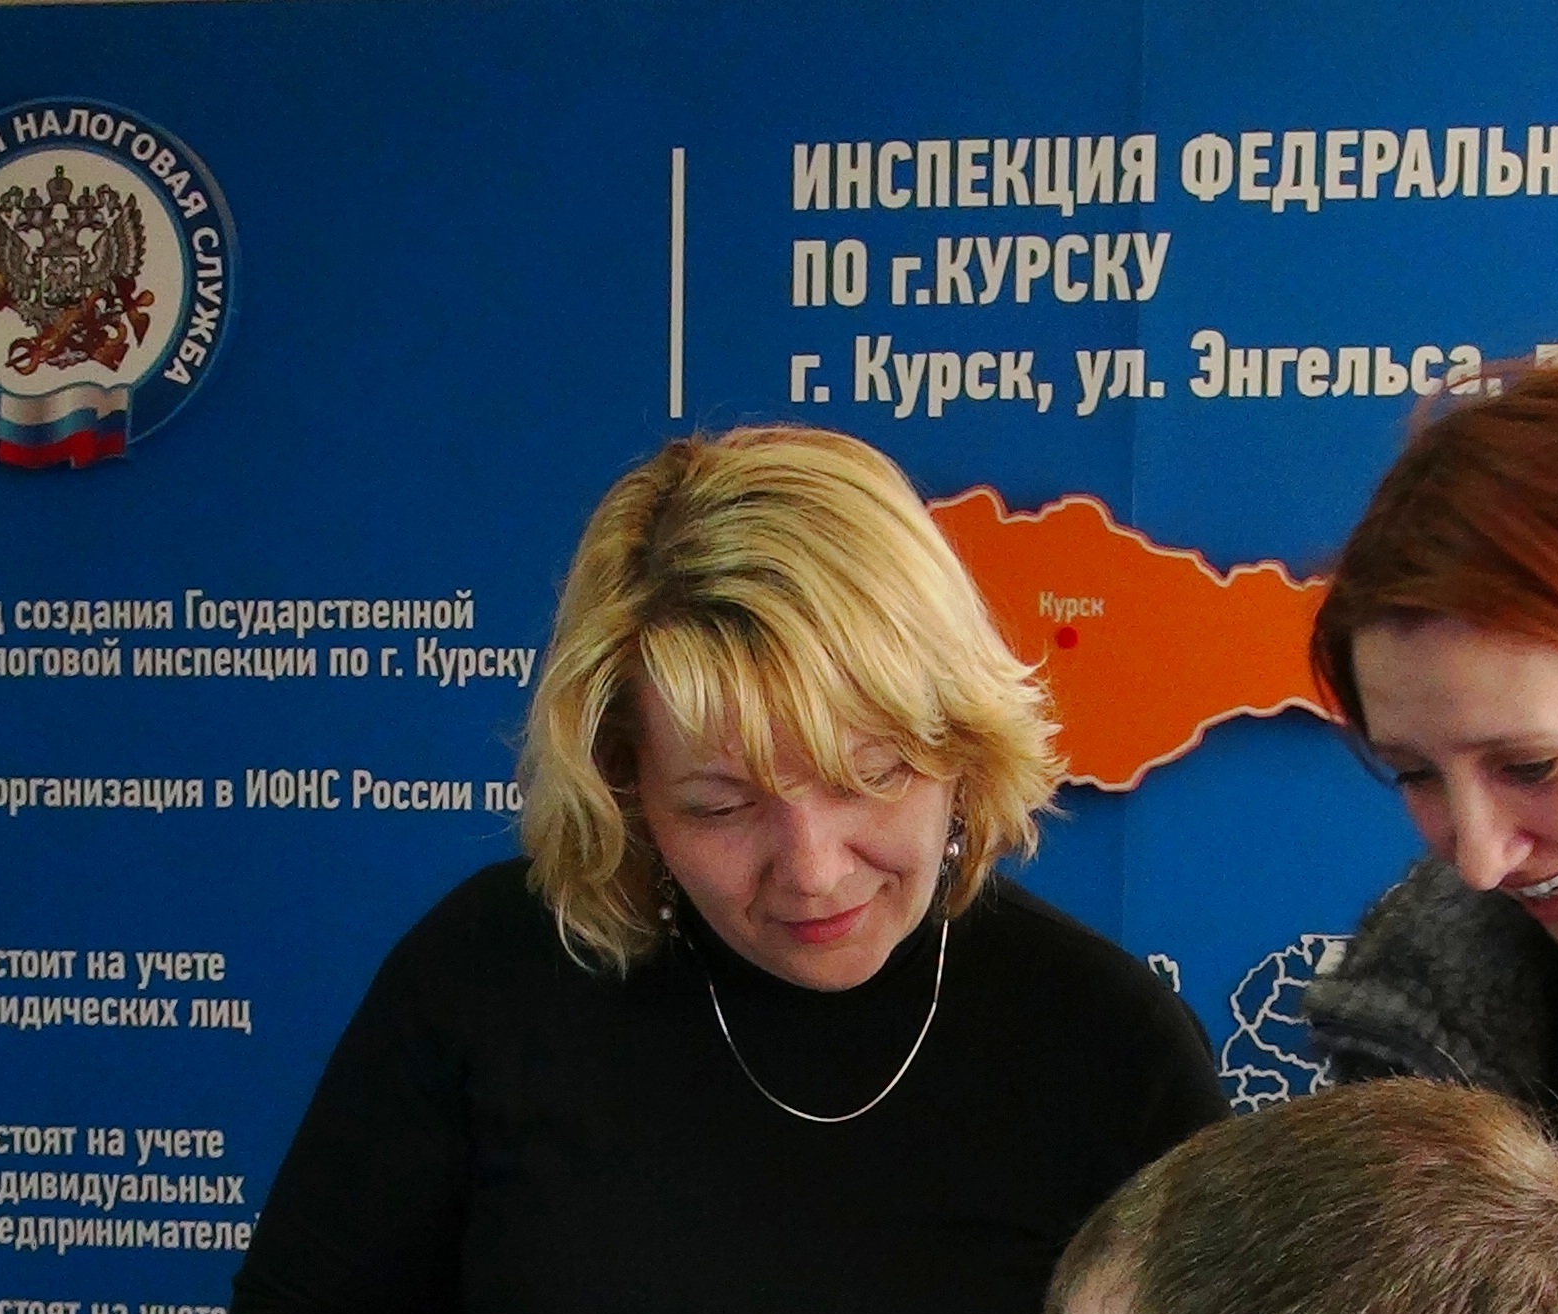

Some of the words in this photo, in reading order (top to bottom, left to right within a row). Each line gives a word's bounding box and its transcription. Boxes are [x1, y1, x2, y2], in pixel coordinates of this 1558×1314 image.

[793, 134, 1157, 217] ИНСПЕКЦИЯ
[11, 108, 209, 219] НАЛОГОВАЯ
[163, 226, 224, 386] СЛУЖБА
[792, 238, 868, 307] ПО
[891, 232, 1171, 305] г.КУРСКУ
[790, 354, 830, 403] г.
[854, 335, 1053, 419] Курск,
[1075, 348, 1165, 417] ул.
[1189, 329, 1503, 400] Энгельса,
[14, 600, 173, 636] создания
[185, 589, 474, 639] Государственной
[1038, 591, 1105, 622] Курск
[133, 647, 317, 681] инспекции
[329, 647, 369, 677] по
[380, 647, 404, 677] г.
[416, 636, 537, 688] Курску
[215, 779, 234, 808] в
[246, 768, 341, 809] ИФНС
[352, 769, 472, 811] России
[484, 781, 525, 811] по
[86, 951, 126, 980] на
[135, 952, 225, 990] учете
[188, 998, 252, 1034] лиц
[87, 1127, 125, 1156] на
[135, 1129, 224, 1167] учете
